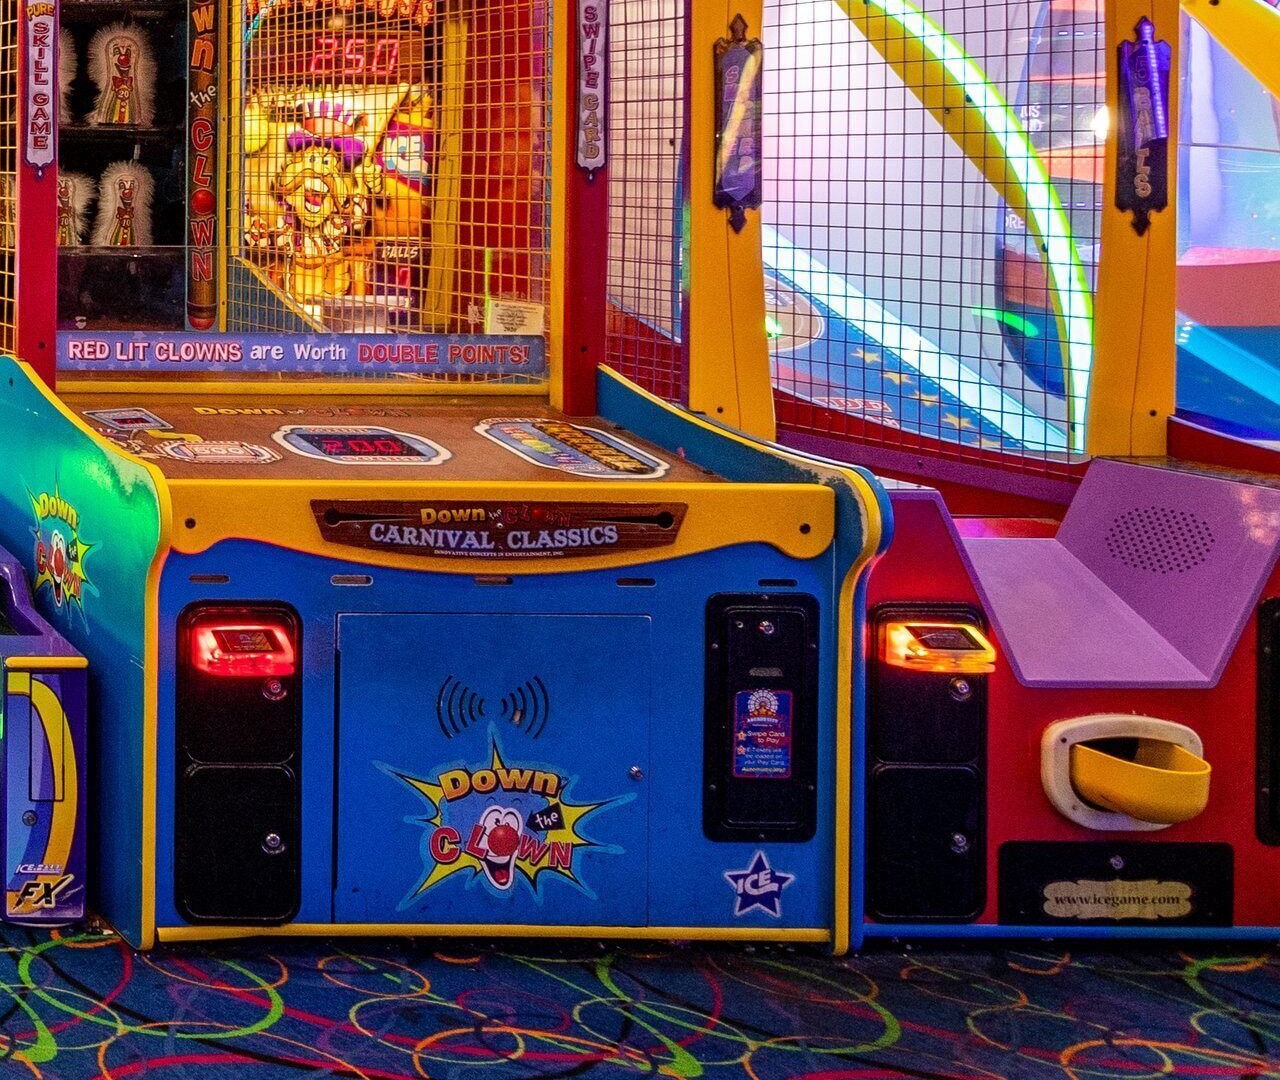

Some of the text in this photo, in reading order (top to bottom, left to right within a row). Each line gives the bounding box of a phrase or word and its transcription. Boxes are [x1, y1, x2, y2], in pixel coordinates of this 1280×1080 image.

[309, 37, 401, 75] 250
[26, 2, 55, 150] PURE SKILL GAME
[583, 6, 601, 159] SWIPE CARD
[118, 89, 130, 99] 20
[190, 84, 217, 108] the
[190, 115, 217, 283] CLOWN
[382, 245, 419, 259] BALLS
[68, 341, 530, 365] RED LIT CLOWNS are Worth DOUBLE POINTS!
[369, 523, 619, 550] CARNIVAL CLASSICS
[534, 808, 560, 830] the
[430, 825, 574, 869] CLOWN
[12, 874, 75, 911] FX
[736, 868, 780, 896] ICE
[1054, 891, 1181, 908] www.icegame.com
